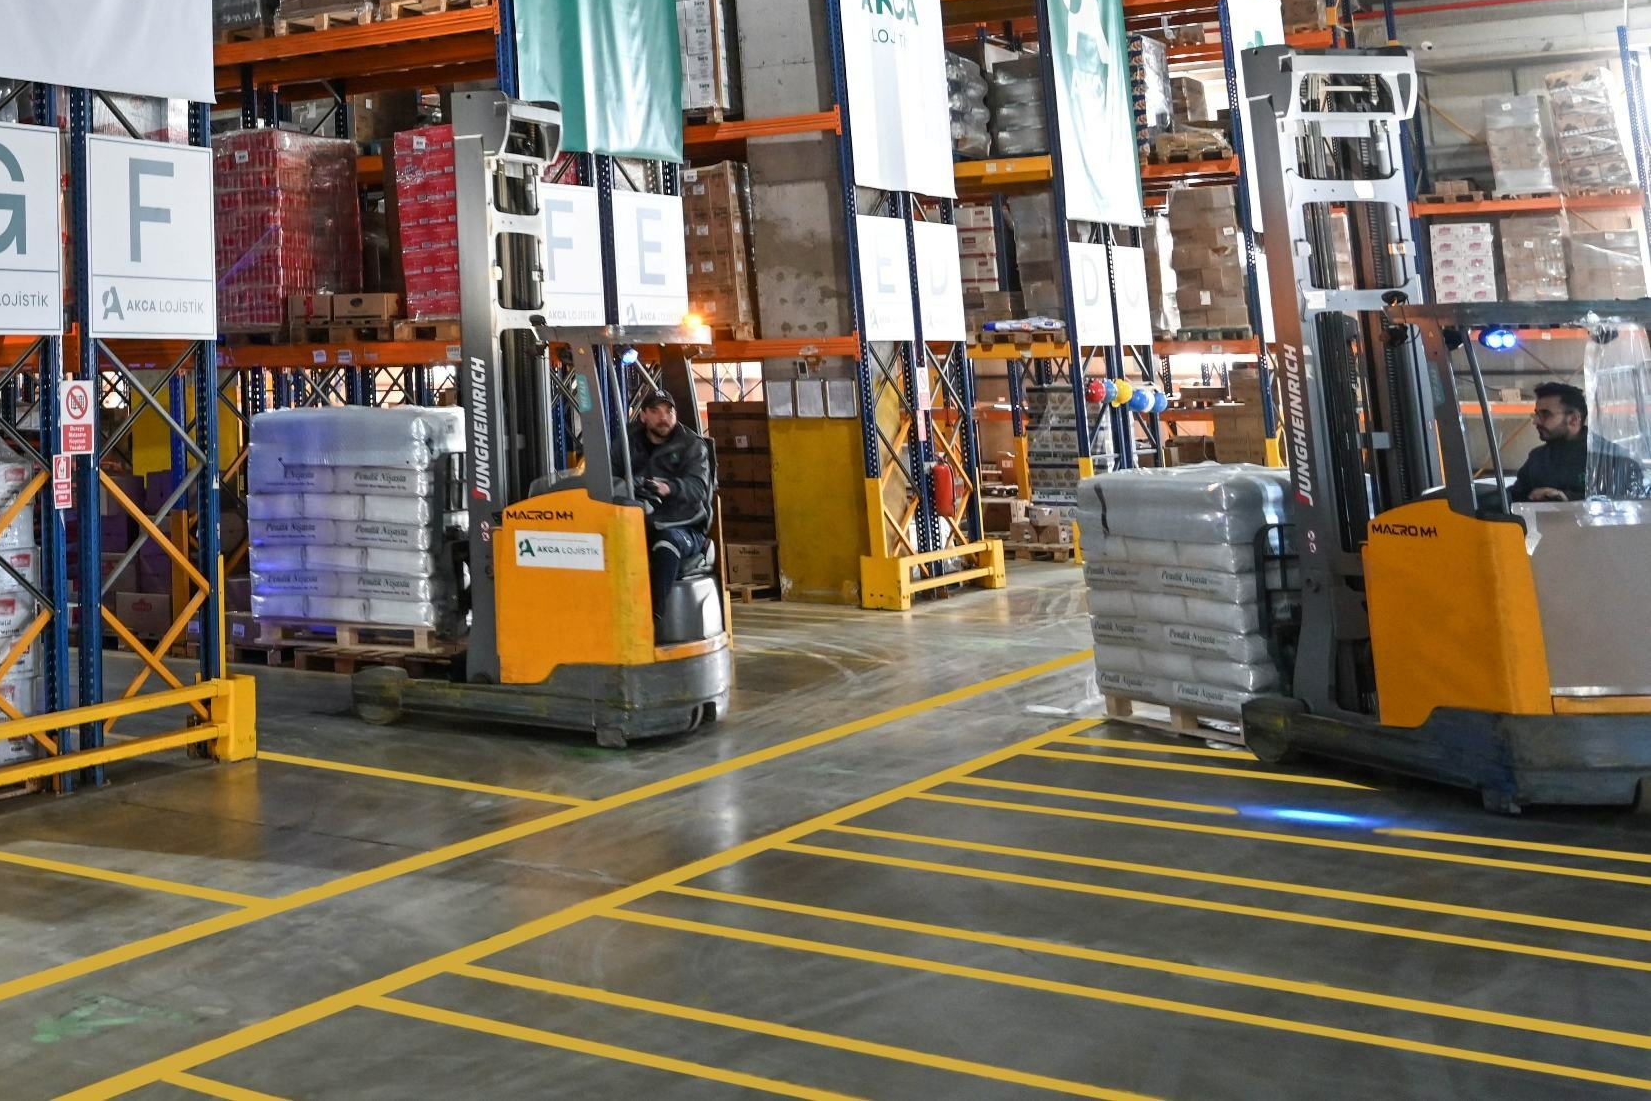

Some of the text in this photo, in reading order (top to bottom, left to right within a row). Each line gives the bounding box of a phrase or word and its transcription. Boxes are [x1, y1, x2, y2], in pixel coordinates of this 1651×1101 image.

[128, 157, 175, 263] F
[545, 198, 574, 281] F
[636, 207, 666, 285] E
[126, 298, 204, 315] AKCA LOJİSTİK
[548, 309, 567, 319] AKCA
[470, 356, 492, 502] JUNGHEINRICH
[1283, 344, 1313, 507] JUNGHEINRICH
[506, 510, 554, 521] MACRO
[1371, 523, 1418, 536] MACRO
[537, 544, 560, 555] AKCA
